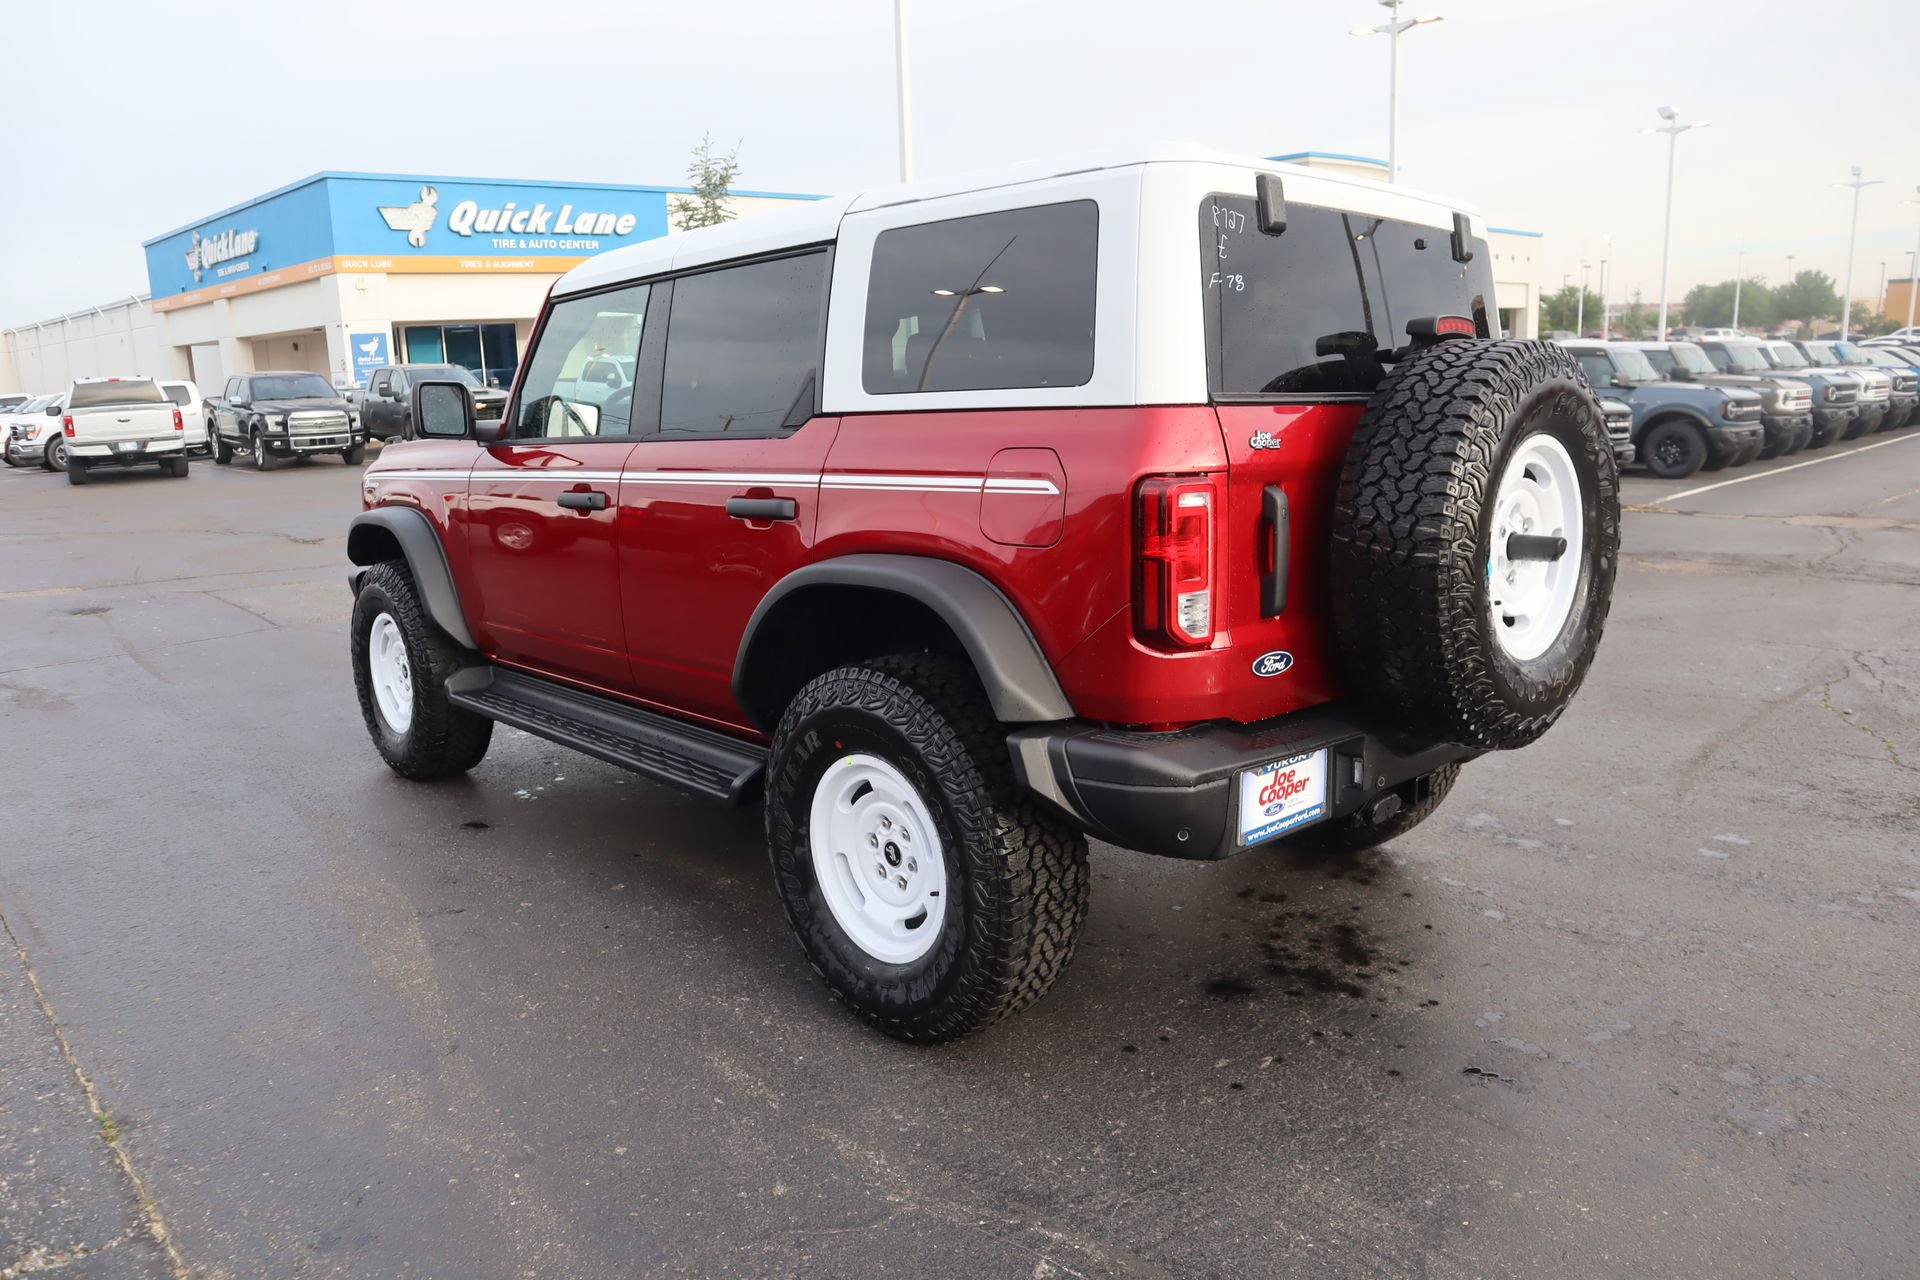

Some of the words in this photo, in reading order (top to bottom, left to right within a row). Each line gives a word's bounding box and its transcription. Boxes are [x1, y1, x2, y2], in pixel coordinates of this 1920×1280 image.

[449, 200, 552, 237] Quick
[553, 204, 636, 236] Lane
[201, 232, 228, 270] Quick
[228, 229, 258, 258] Lane
[492, 239, 517, 249] TIRE
[519, 239, 527, 249] &
[528, 240, 557, 249] AUTO
[559, 240, 599, 249] CENTER
[341, 260, 369, 268] QUICK
[371, 260, 393, 268] LUBE
[460, 260, 483, 268] TIRES
[492, 260, 535, 268] ALIGNMENT
[1256, 430, 1272, 440] Joe
[1250, 437, 1281, 449] Cooper
[1260, 655, 1287, 673] Ford
[1270, 769, 1296, 790] Joe
[1259, 777, 1310, 806] Cooper
